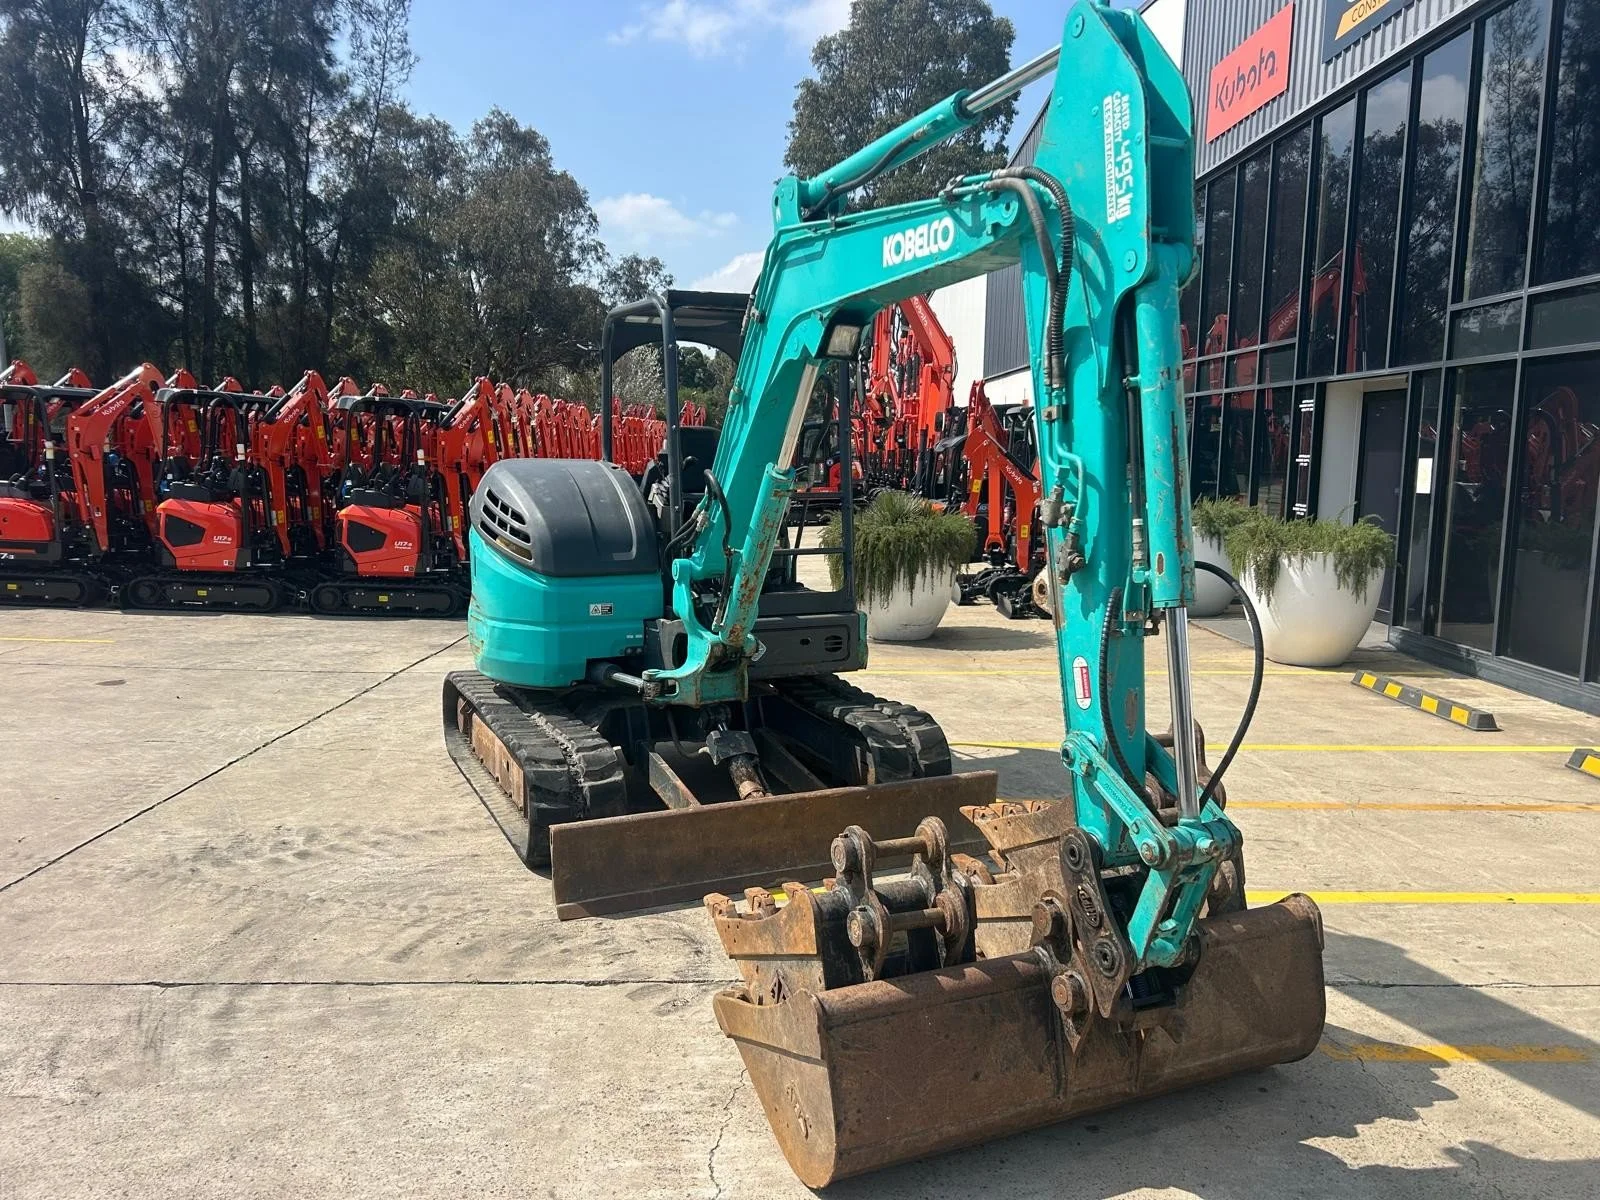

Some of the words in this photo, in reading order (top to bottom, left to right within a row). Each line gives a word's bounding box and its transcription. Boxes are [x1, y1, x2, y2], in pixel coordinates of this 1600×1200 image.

[1351, 0, 1383, 23] CONS
[1214, 47, 1277, 113] Kubota
[1103, 102, 1113, 129] LESS
[1112, 91, 1123, 142] CAPACITY
[1122, 94, 1130, 129] RATED
[1105, 133, 1115, 218] ATTACHMENTS
[882, 216, 954, 269] KOBELCO
[101, 400, 125, 416] Kubota
[1005, 465, 1023, 485] Kubota
